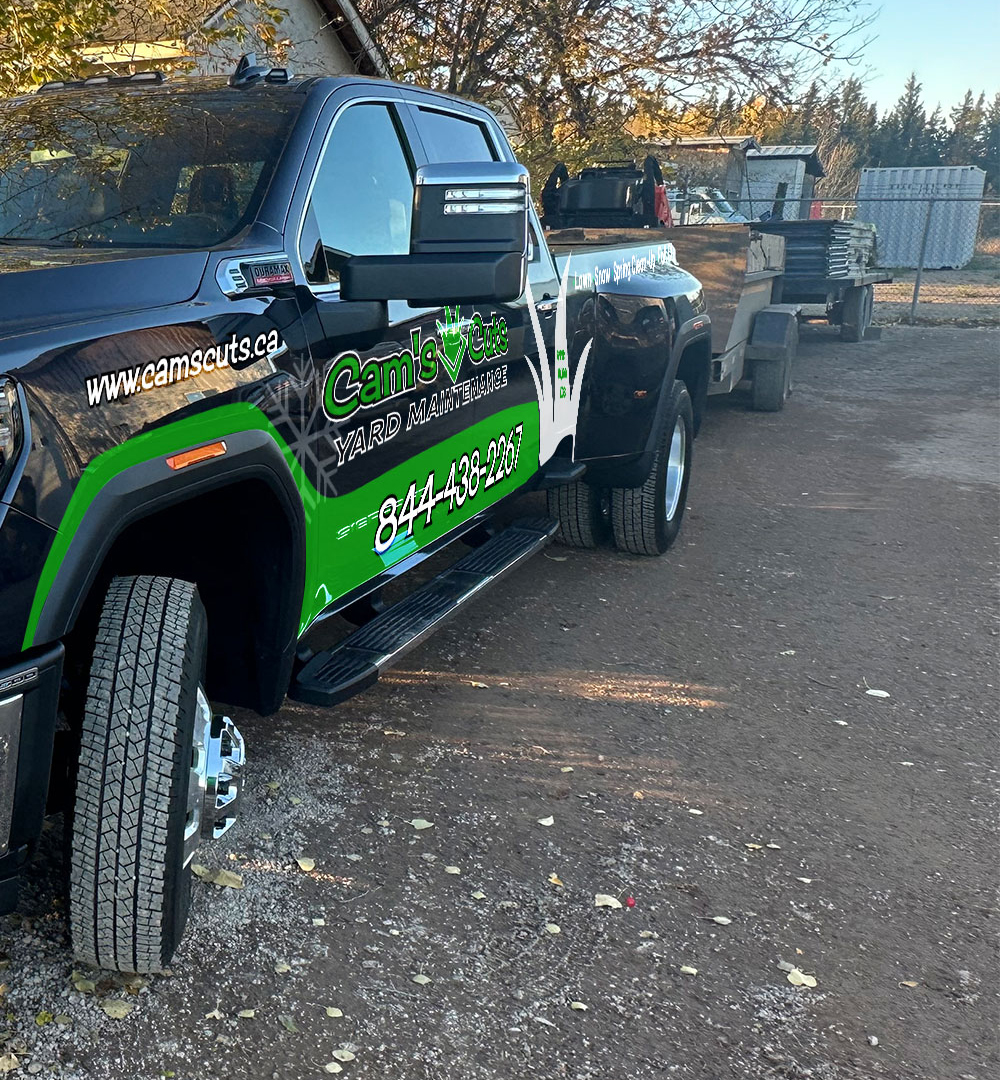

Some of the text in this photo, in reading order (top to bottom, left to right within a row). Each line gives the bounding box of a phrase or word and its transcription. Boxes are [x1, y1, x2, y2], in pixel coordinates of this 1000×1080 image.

[254, 264, 290, 277] DURAMAX
[85, 328, 279, 406] www.camscuts.ca
[322, 312, 509, 422] Cam's Cuts
[334, 412, 402, 467] YARD
[406, 365, 508, 431] MAINTENANCE
[373, 422, 524, 555] 844-438-2267
